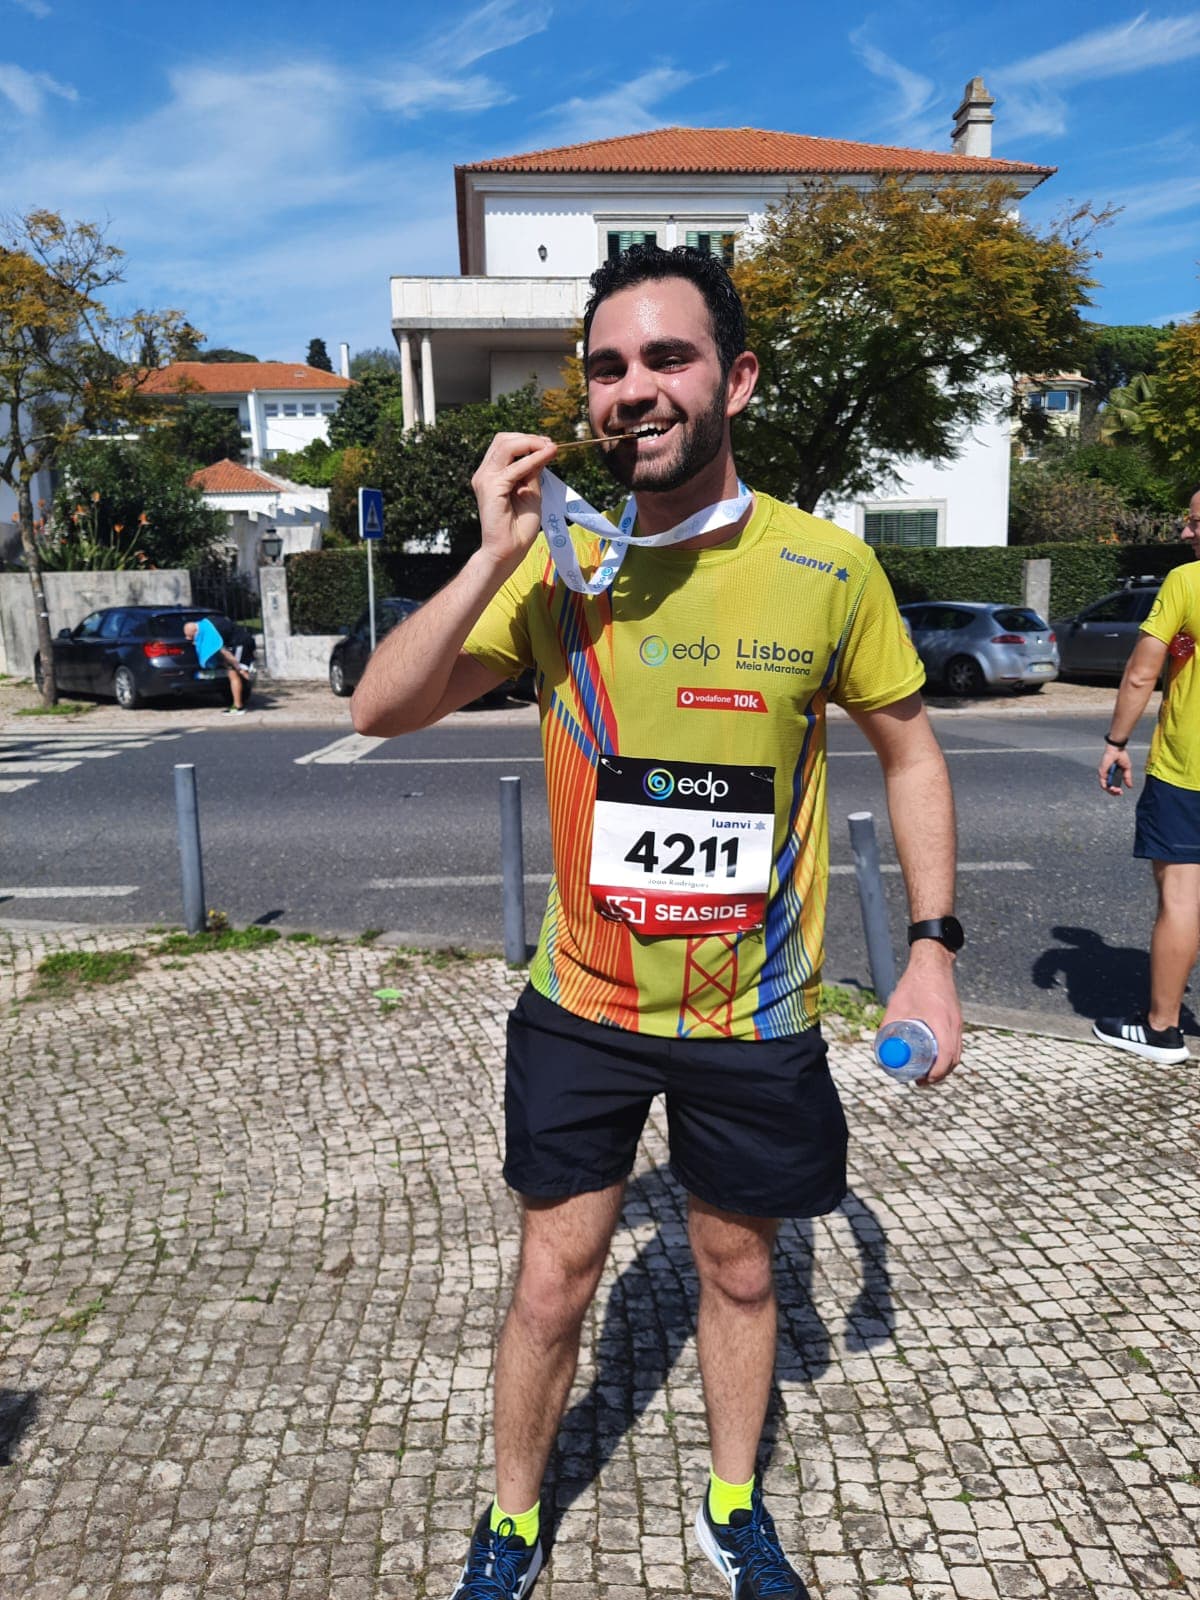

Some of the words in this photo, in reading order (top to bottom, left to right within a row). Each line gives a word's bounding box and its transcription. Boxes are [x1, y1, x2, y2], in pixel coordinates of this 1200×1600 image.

[780, 547, 834, 573] luanvi
[672, 636, 720, 667] edp
[737, 638, 814, 665] Lisboa
[736, 660, 762, 671] Meia
[764, 662, 811, 676] Maratona
[695, 694, 731, 704] vodafone
[733, 694, 759, 709] 10k
[677, 771, 729, 804] edp
[711, 818, 751, 830] luanvi
[624, 831, 739, 878] 4211
[654, 904, 748, 922] SEASIDE
